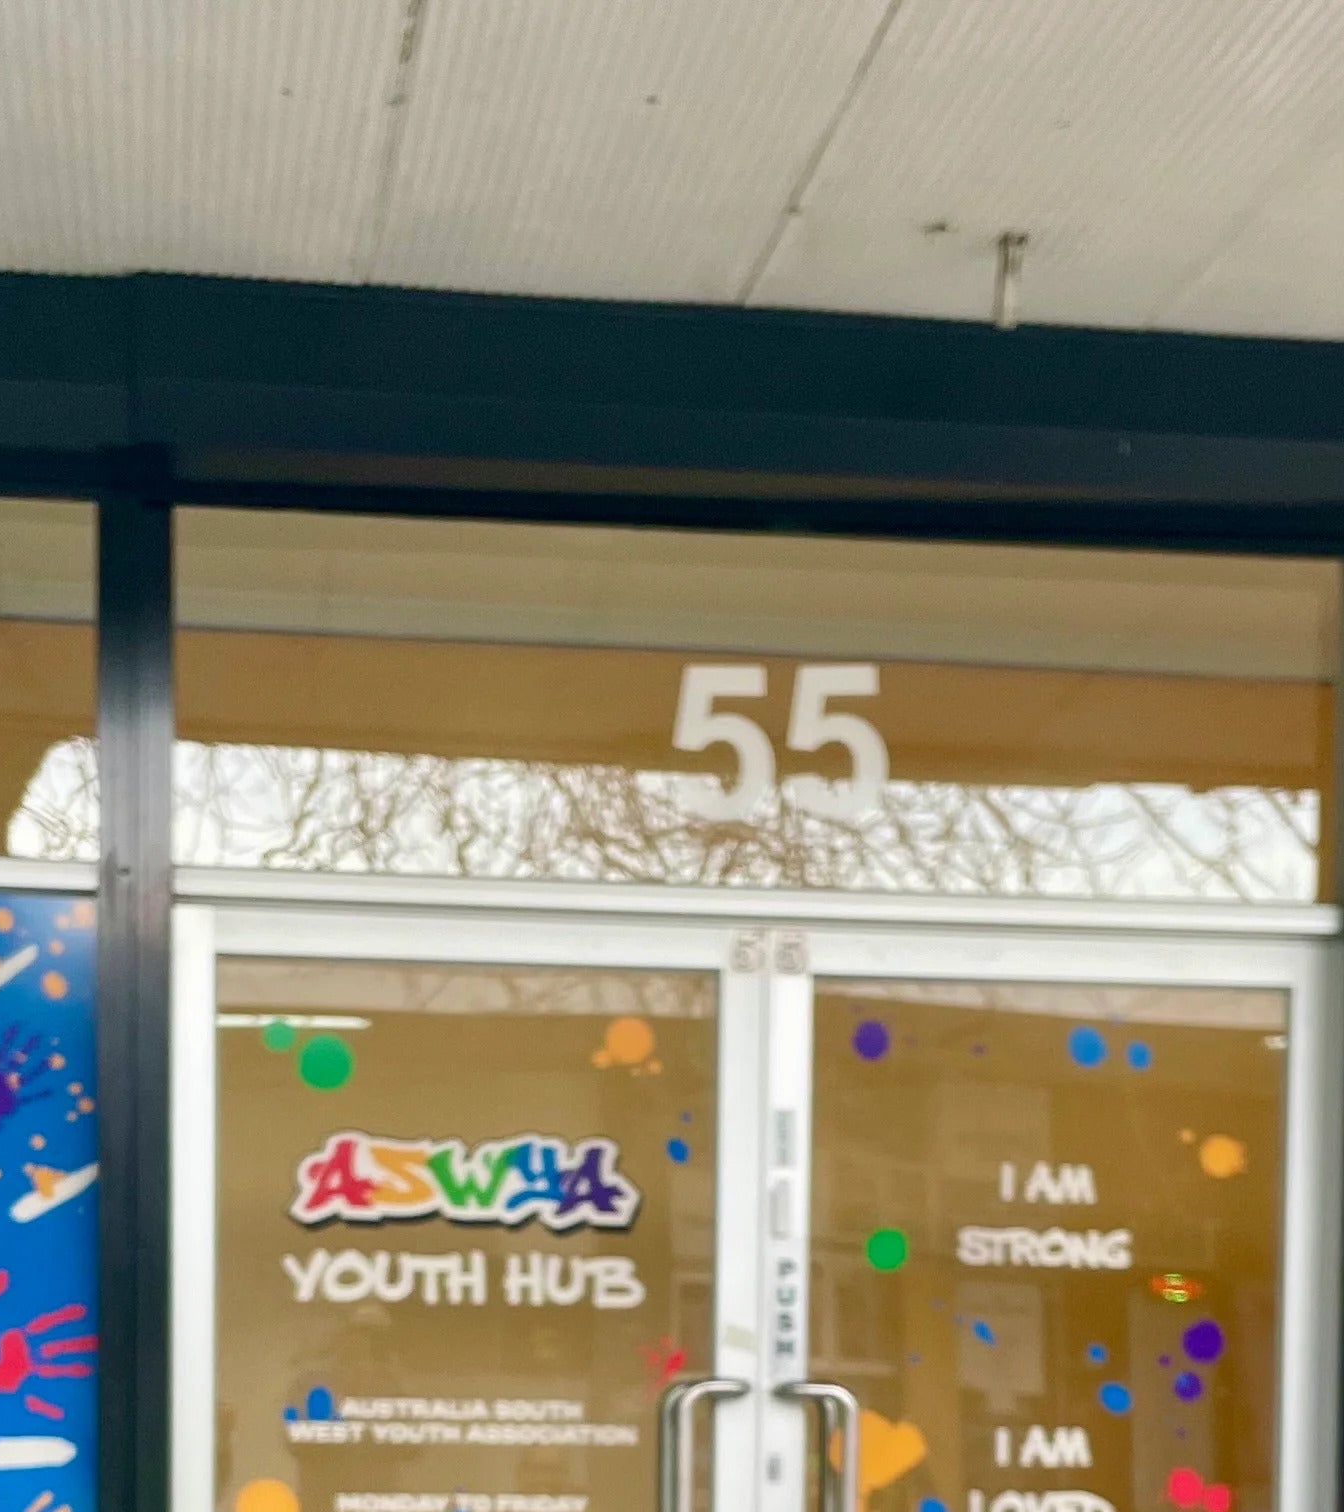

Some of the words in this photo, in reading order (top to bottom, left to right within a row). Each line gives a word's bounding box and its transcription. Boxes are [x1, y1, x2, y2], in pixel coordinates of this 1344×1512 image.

[670, 663, 892, 822] 55
[297, 1133, 633, 1220] ASWYA
[1000, 1163, 1015, 1201] I
[1025, 1162, 1096, 1205] AM
[957, 1226, 1132, 1269] STRONG
[282, 1249, 487, 1305] YOUTH
[503, 1250, 646, 1308] HUB
[340, 1397, 489, 1420] AUSTRALIA
[496, 1399, 584, 1422] SOUTH
[286, 1420, 365, 1443] WEST
[372, 1422, 461, 1444] YOUTH
[465, 1423, 638, 1446] ASSOCIATION
[994, 1427, 1010, 1467] I
[1020, 1426, 1091, 1468] AM
